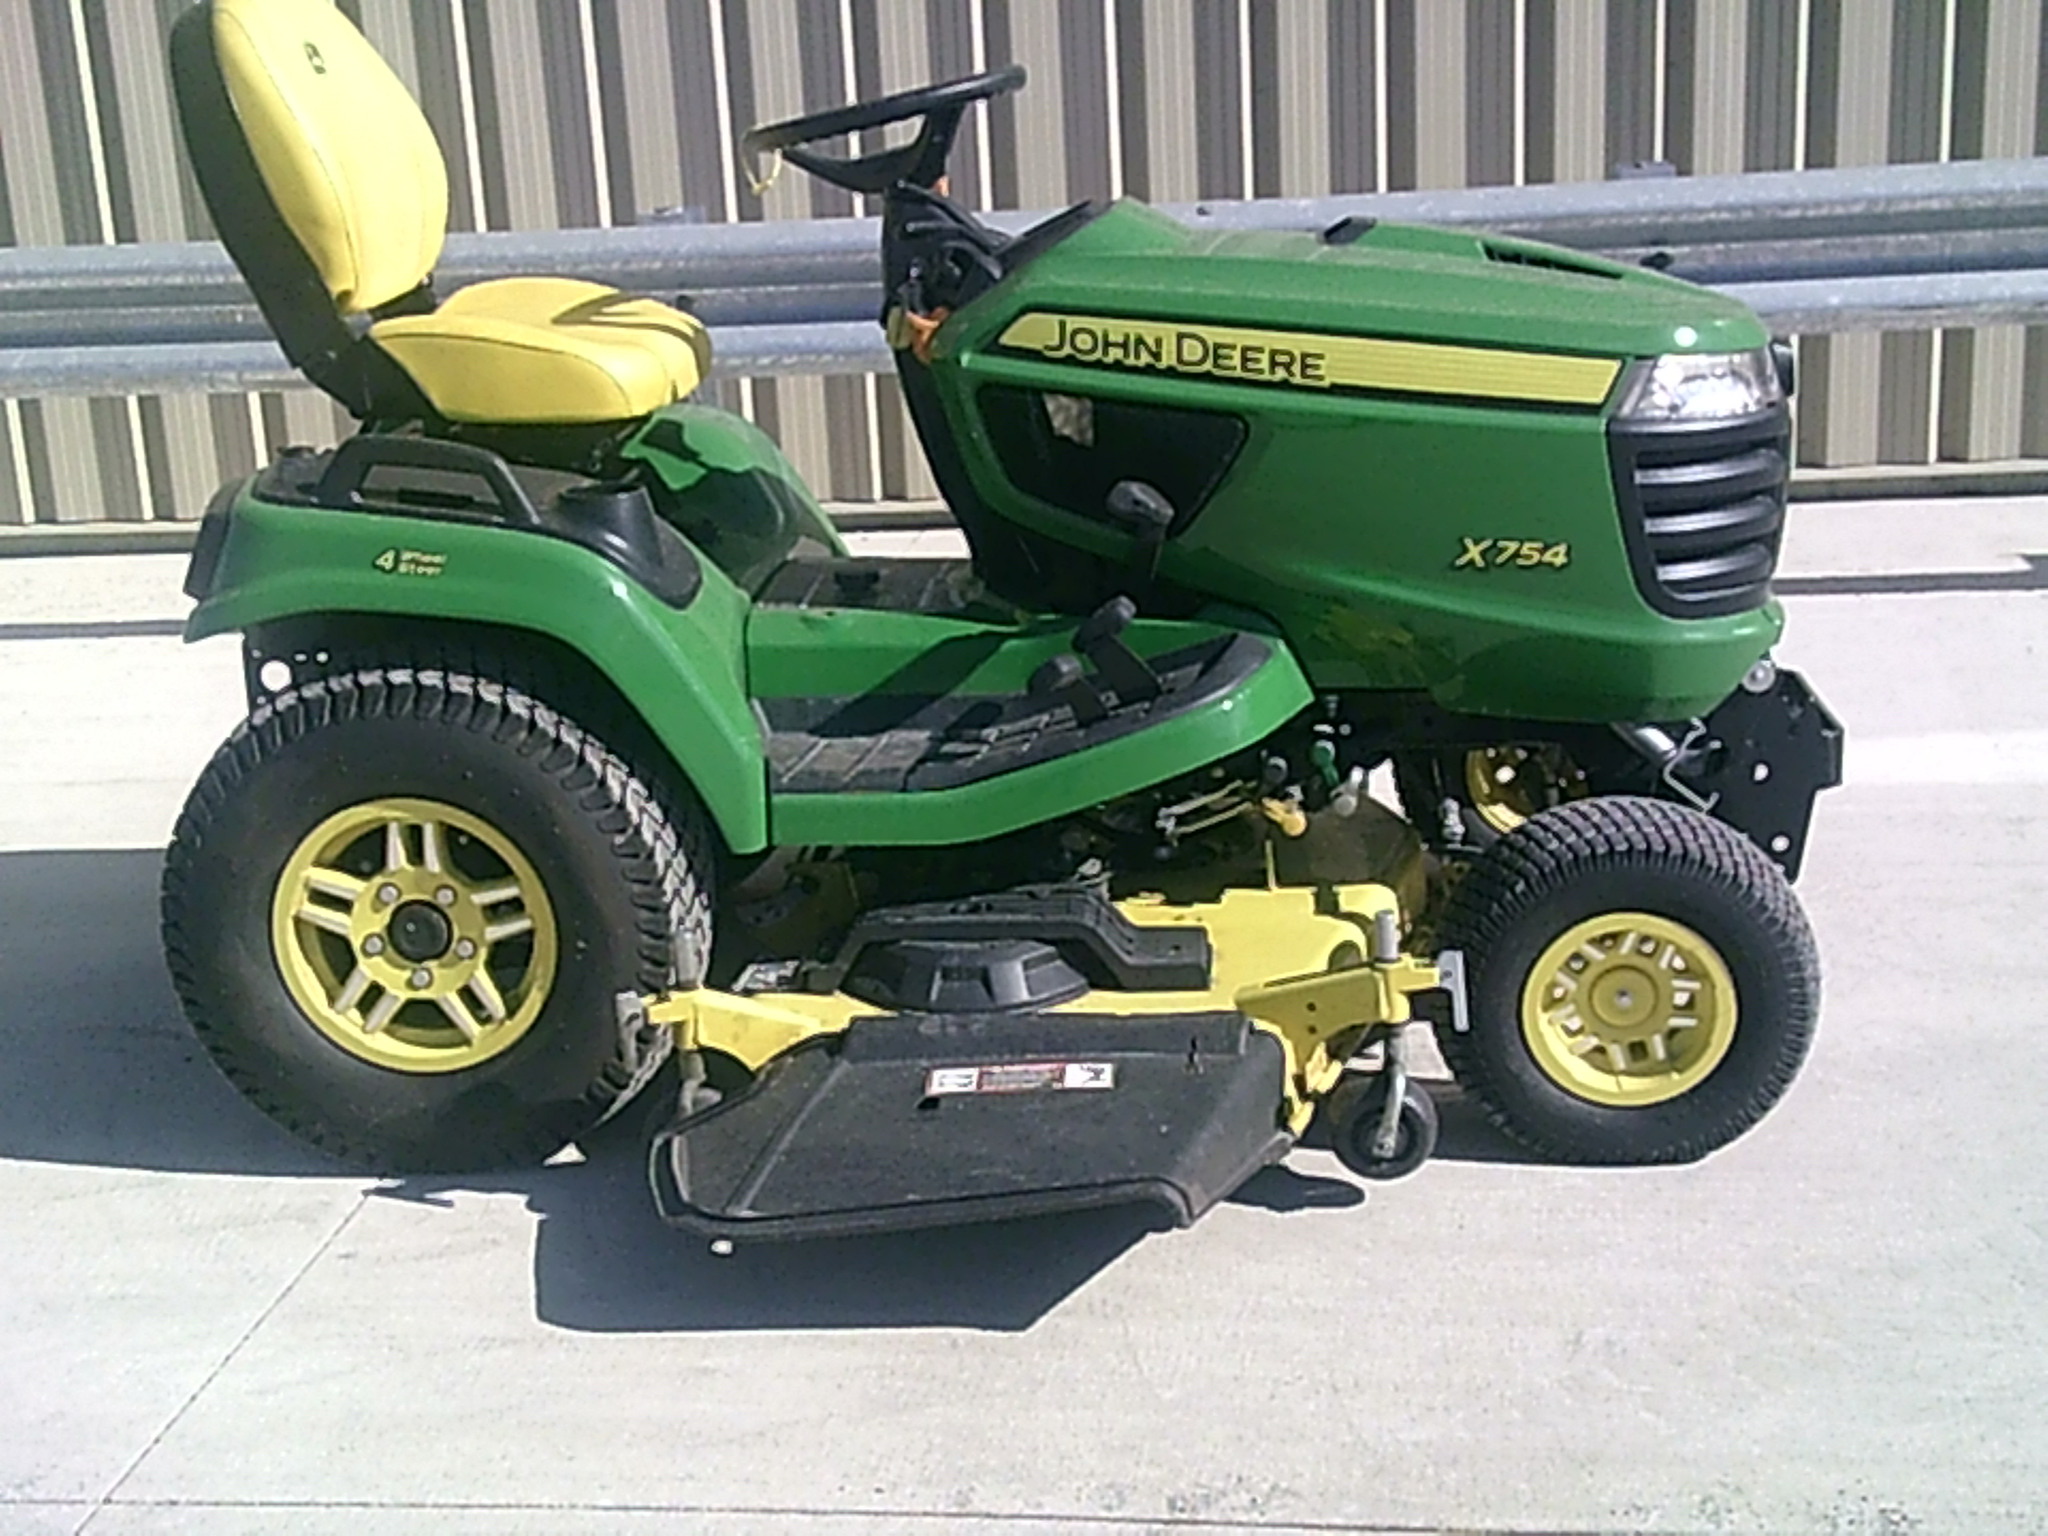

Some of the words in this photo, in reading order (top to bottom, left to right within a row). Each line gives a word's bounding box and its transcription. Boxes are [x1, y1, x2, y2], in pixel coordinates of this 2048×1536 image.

[1043, 318, 1164, 363] JOHN
[1175, 330, 1326, 382] DEERE
[374, 548, 396, 571] 4
[1453, 536, 1569, 569] X754
